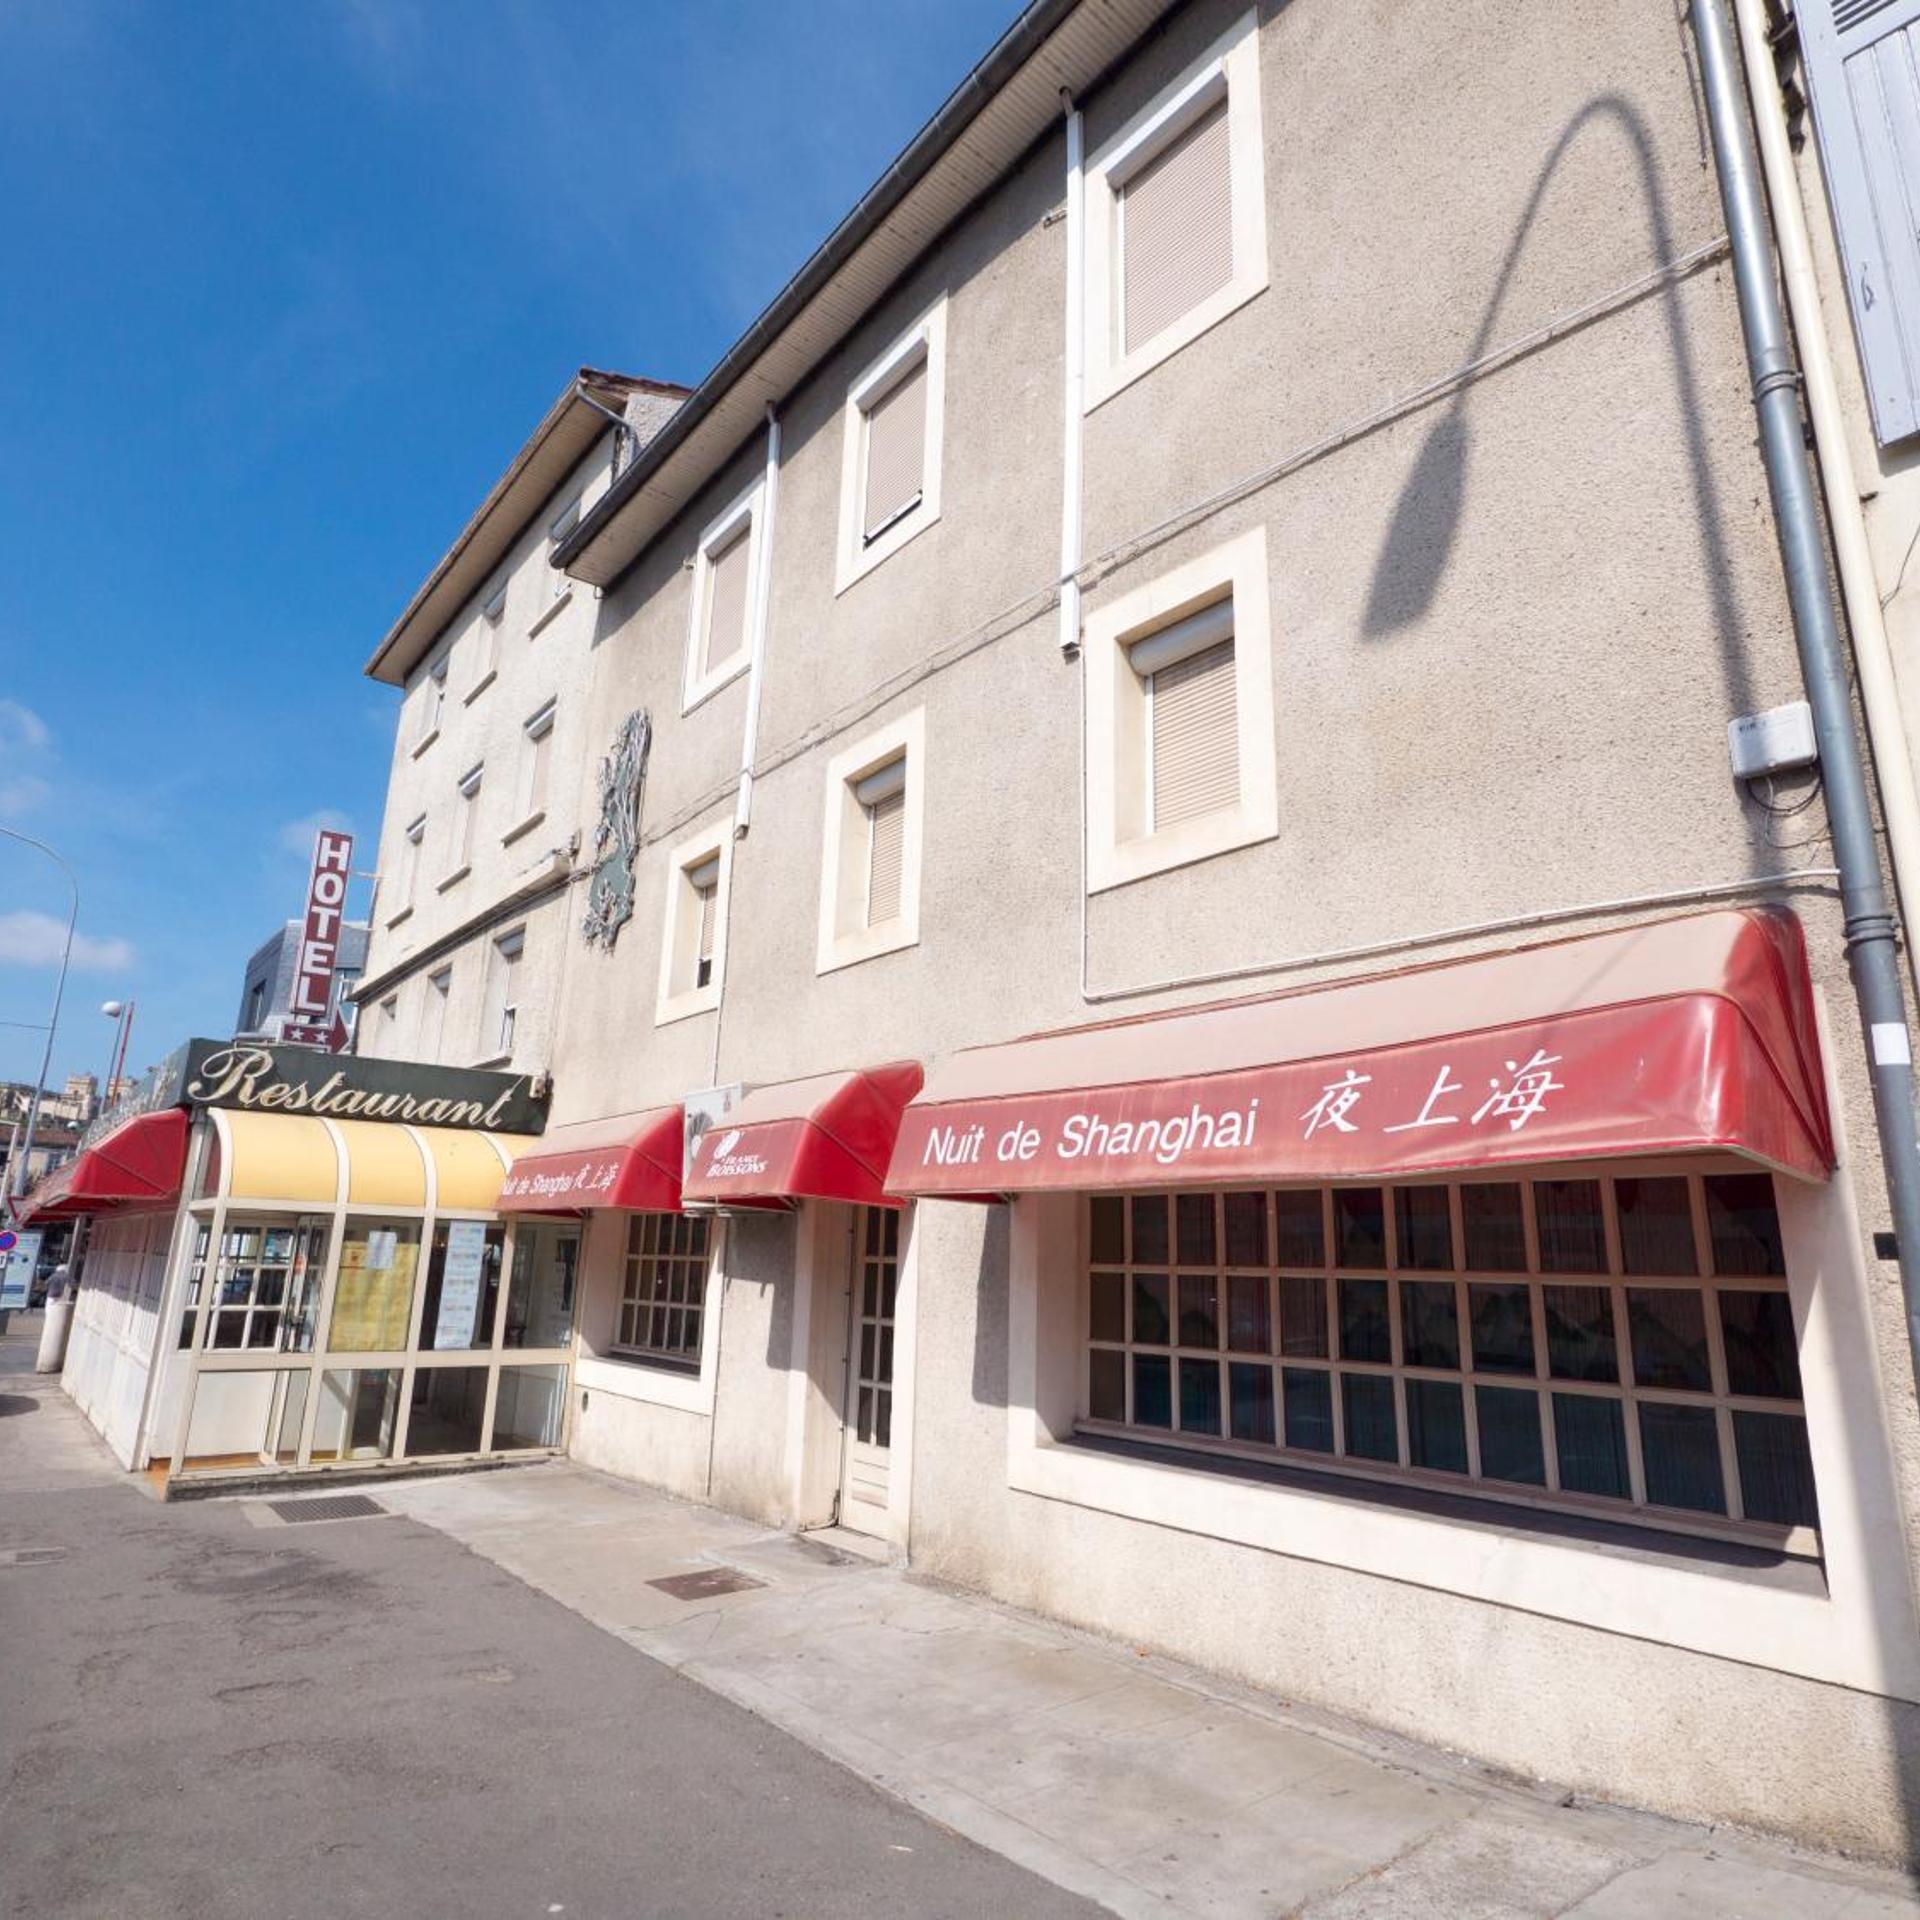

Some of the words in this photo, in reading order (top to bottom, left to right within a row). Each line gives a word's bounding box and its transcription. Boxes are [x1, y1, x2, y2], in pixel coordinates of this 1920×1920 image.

[297, 837, 350, 1011] HOTEL
[187, 1047, 513, 1127] Restaurant
[1298, 1049, 1565, 1140] 夜上海
[923, 1124, 985, 1165] Nuit
[998, 1120, 1041, 1161] de
[1057, 1098, 1259, 1164] Shanghai
